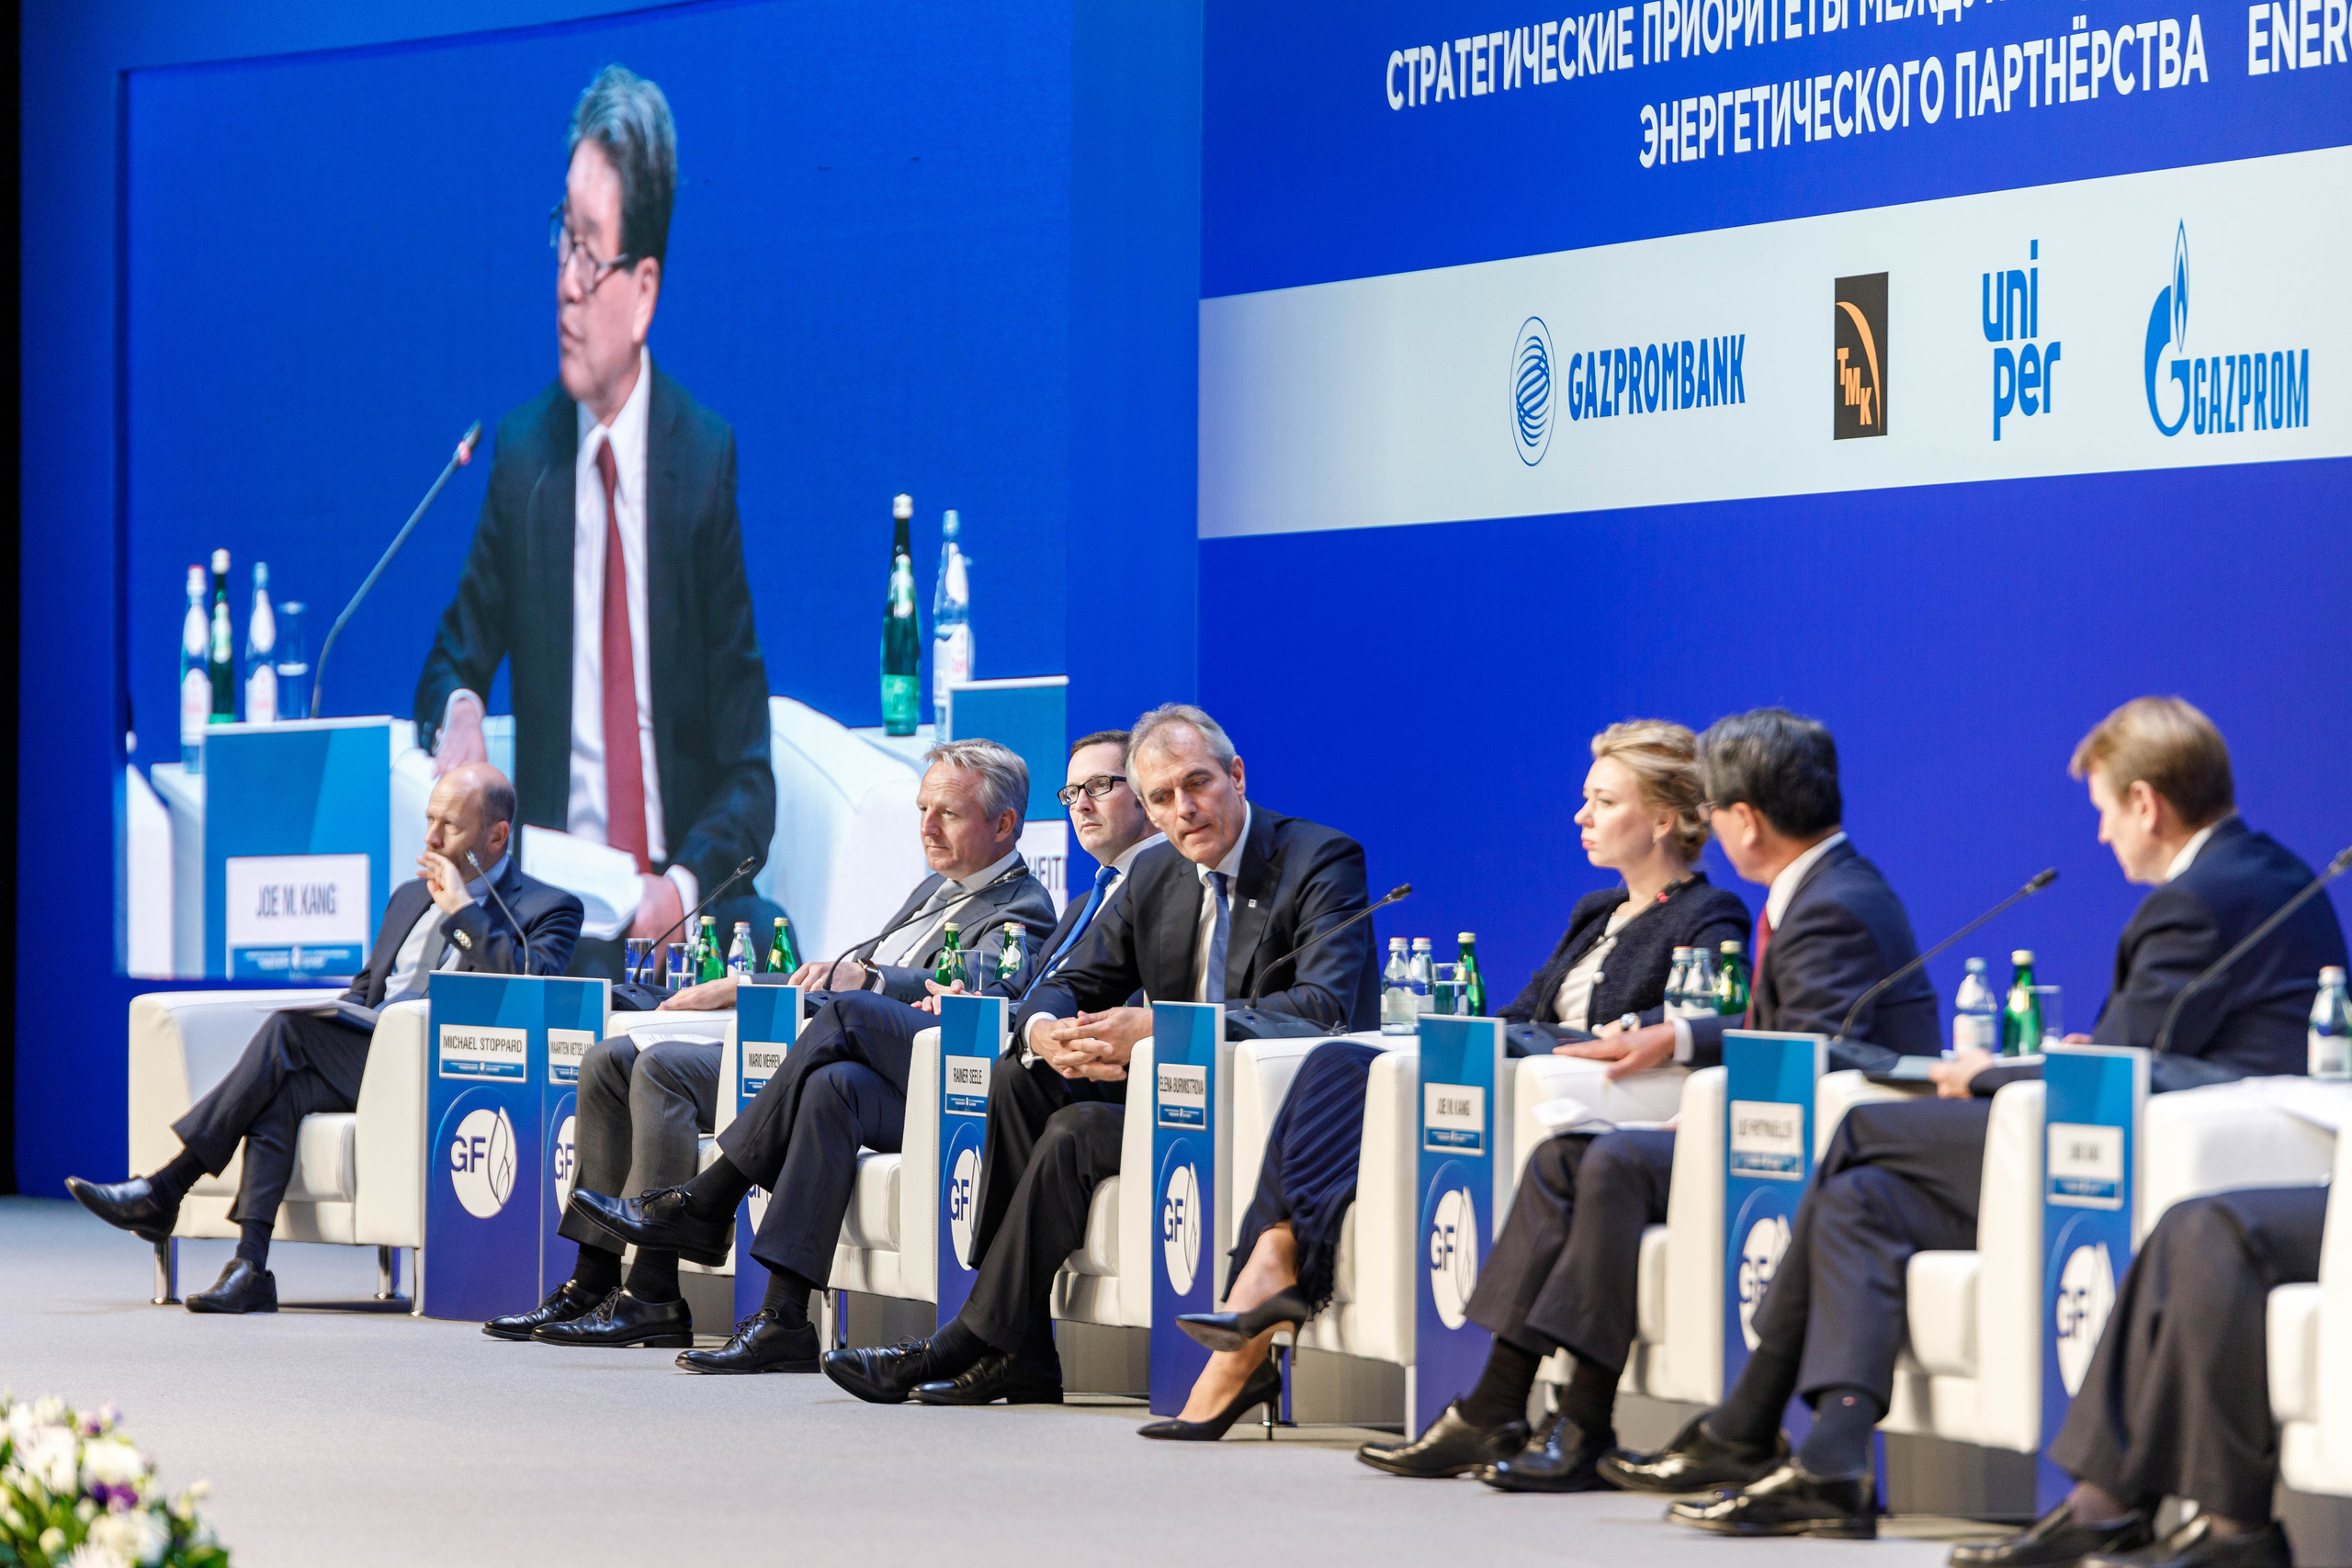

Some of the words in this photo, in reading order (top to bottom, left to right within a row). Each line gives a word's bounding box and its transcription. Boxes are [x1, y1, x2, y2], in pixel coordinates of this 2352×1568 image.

[1386, 6, 1634, 110] СТРАТЕГИЧЕСКИЕ
[1639, 56, 1945, 168] ЭНЕРГЕТИЧЕСКОГО
[1954, 14, 2209, 120] ПАРТНЁРСТВА
[1982, 239, 2038, 343] uni
[1568, 333, 1746, 422] GAZPROMBANK
[1837, 347, 1873, 425] TMK
[1993, 341, 2061, 441] per
[2193, 348, 2309, 435] GAZPROM
[256, 885, 278, 918] JOE
[300, 882, 336, 916] KANG
[443, 1035, 478, 1051] MICHAEL
[480, 1037, 523, 1053] STOPPARD
[1159, 1076, 1172, 1092] ELENA
